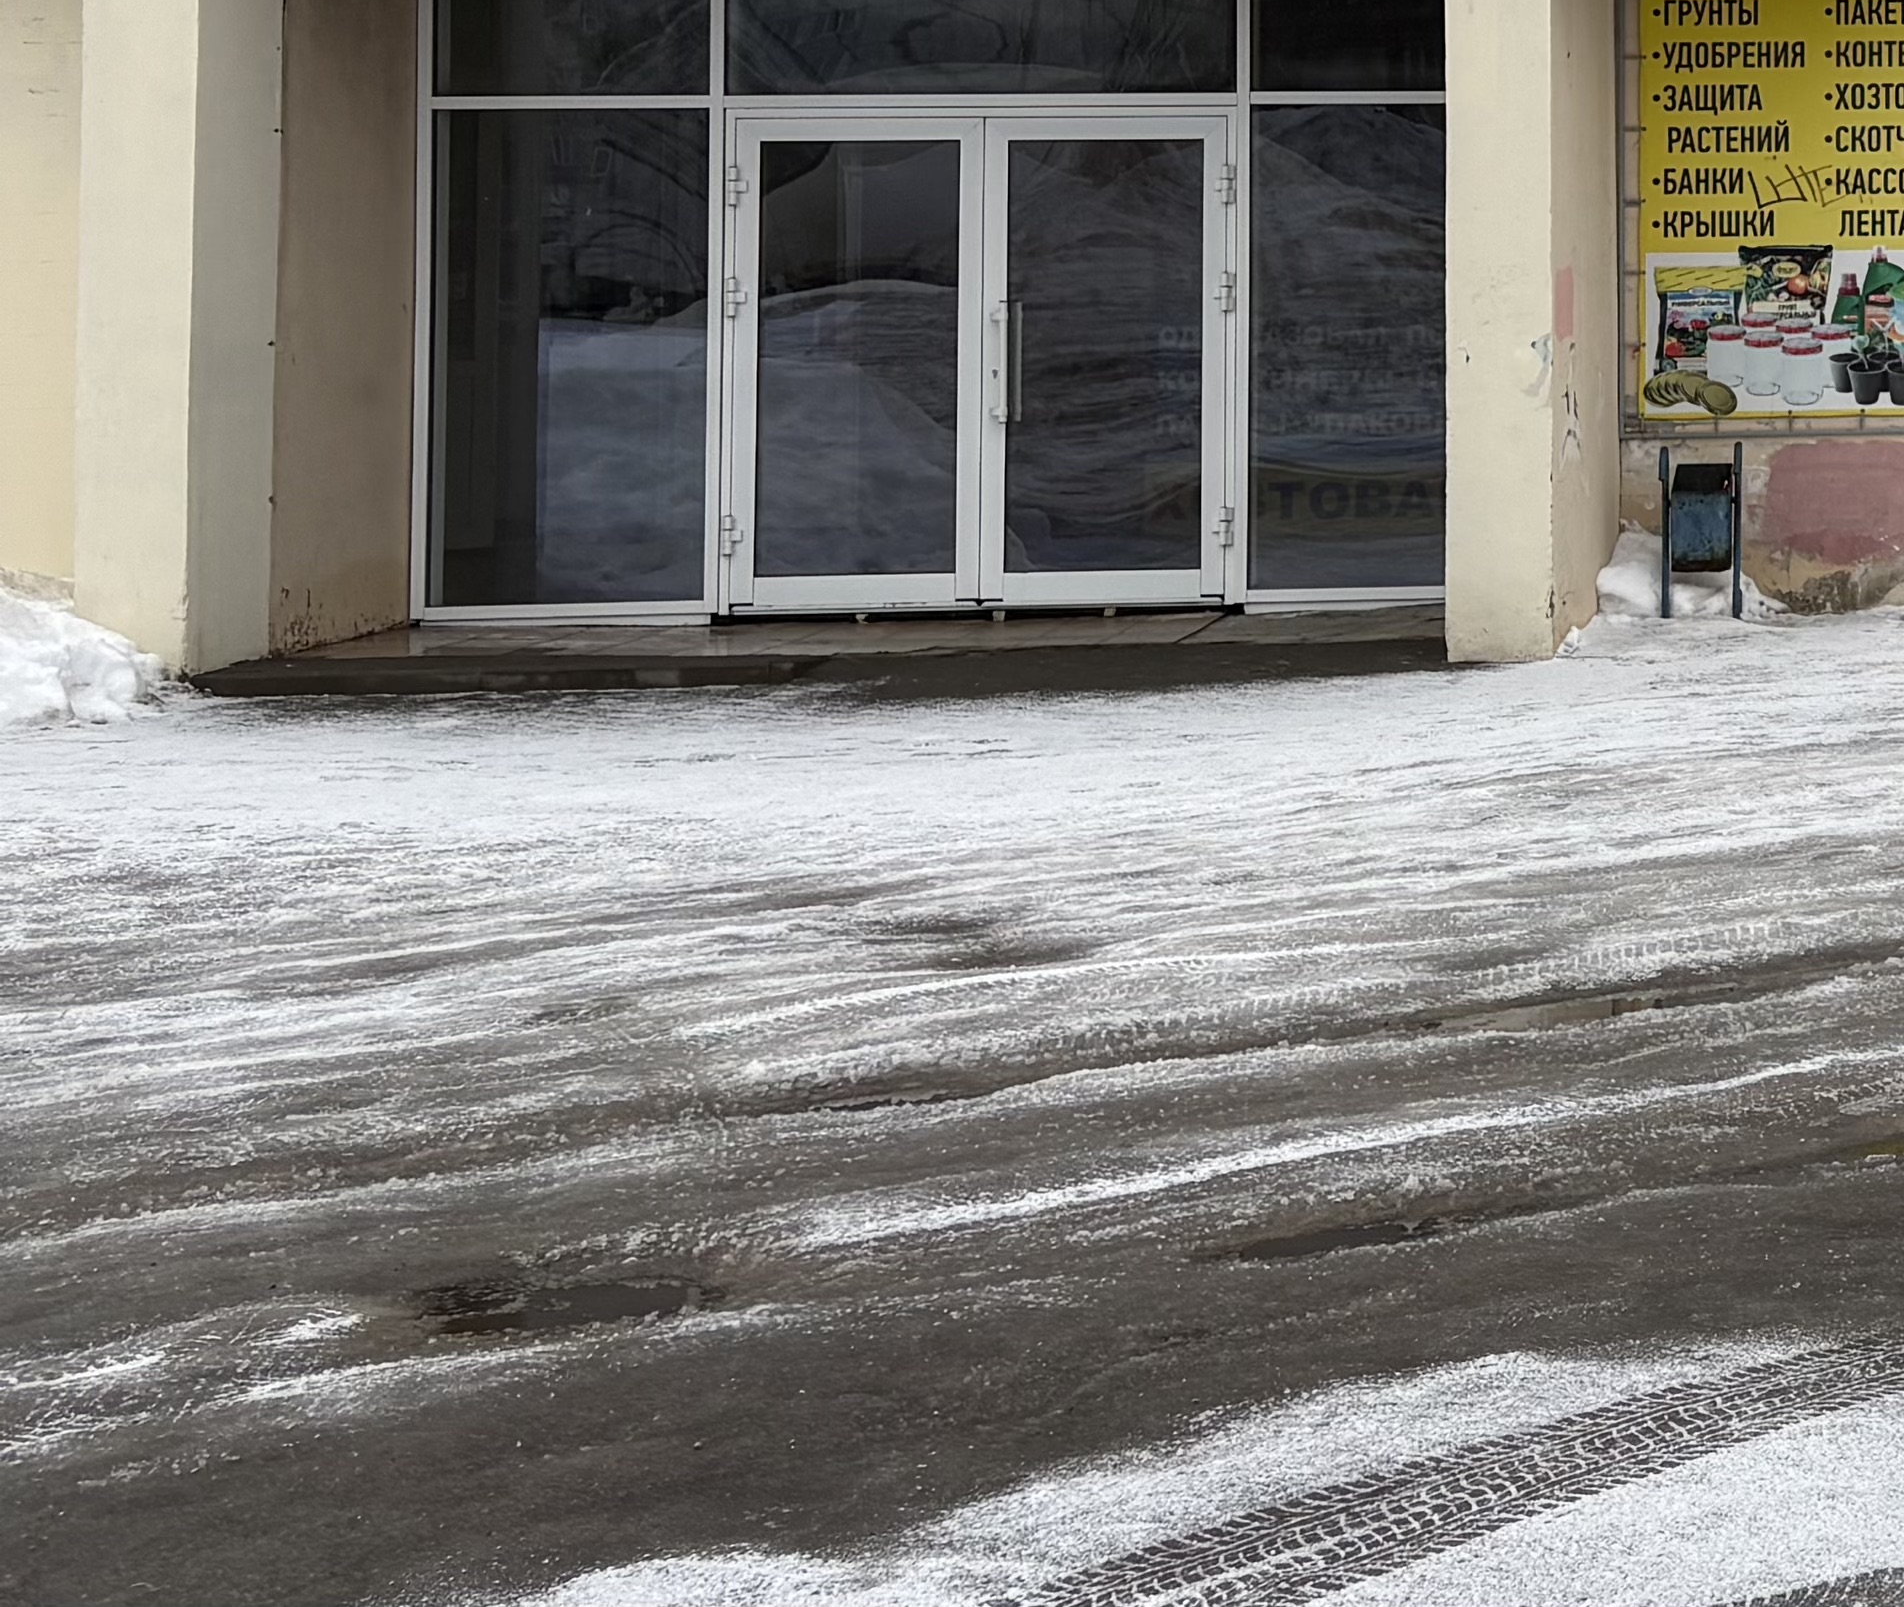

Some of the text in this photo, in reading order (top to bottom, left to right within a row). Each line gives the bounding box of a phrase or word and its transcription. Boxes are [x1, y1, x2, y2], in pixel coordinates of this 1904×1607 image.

[1663, 41, 1806, 74] УДОБРЕНИЯ
[1662, 83, 1764, 116] ЗАЩИТА
[1666, 119, 1791, 154] РАСТЕНИЙ
[1662, 166, 1745, 196] БАНКИ
[1662, 208, 1776, 239] КРЫШКИ
